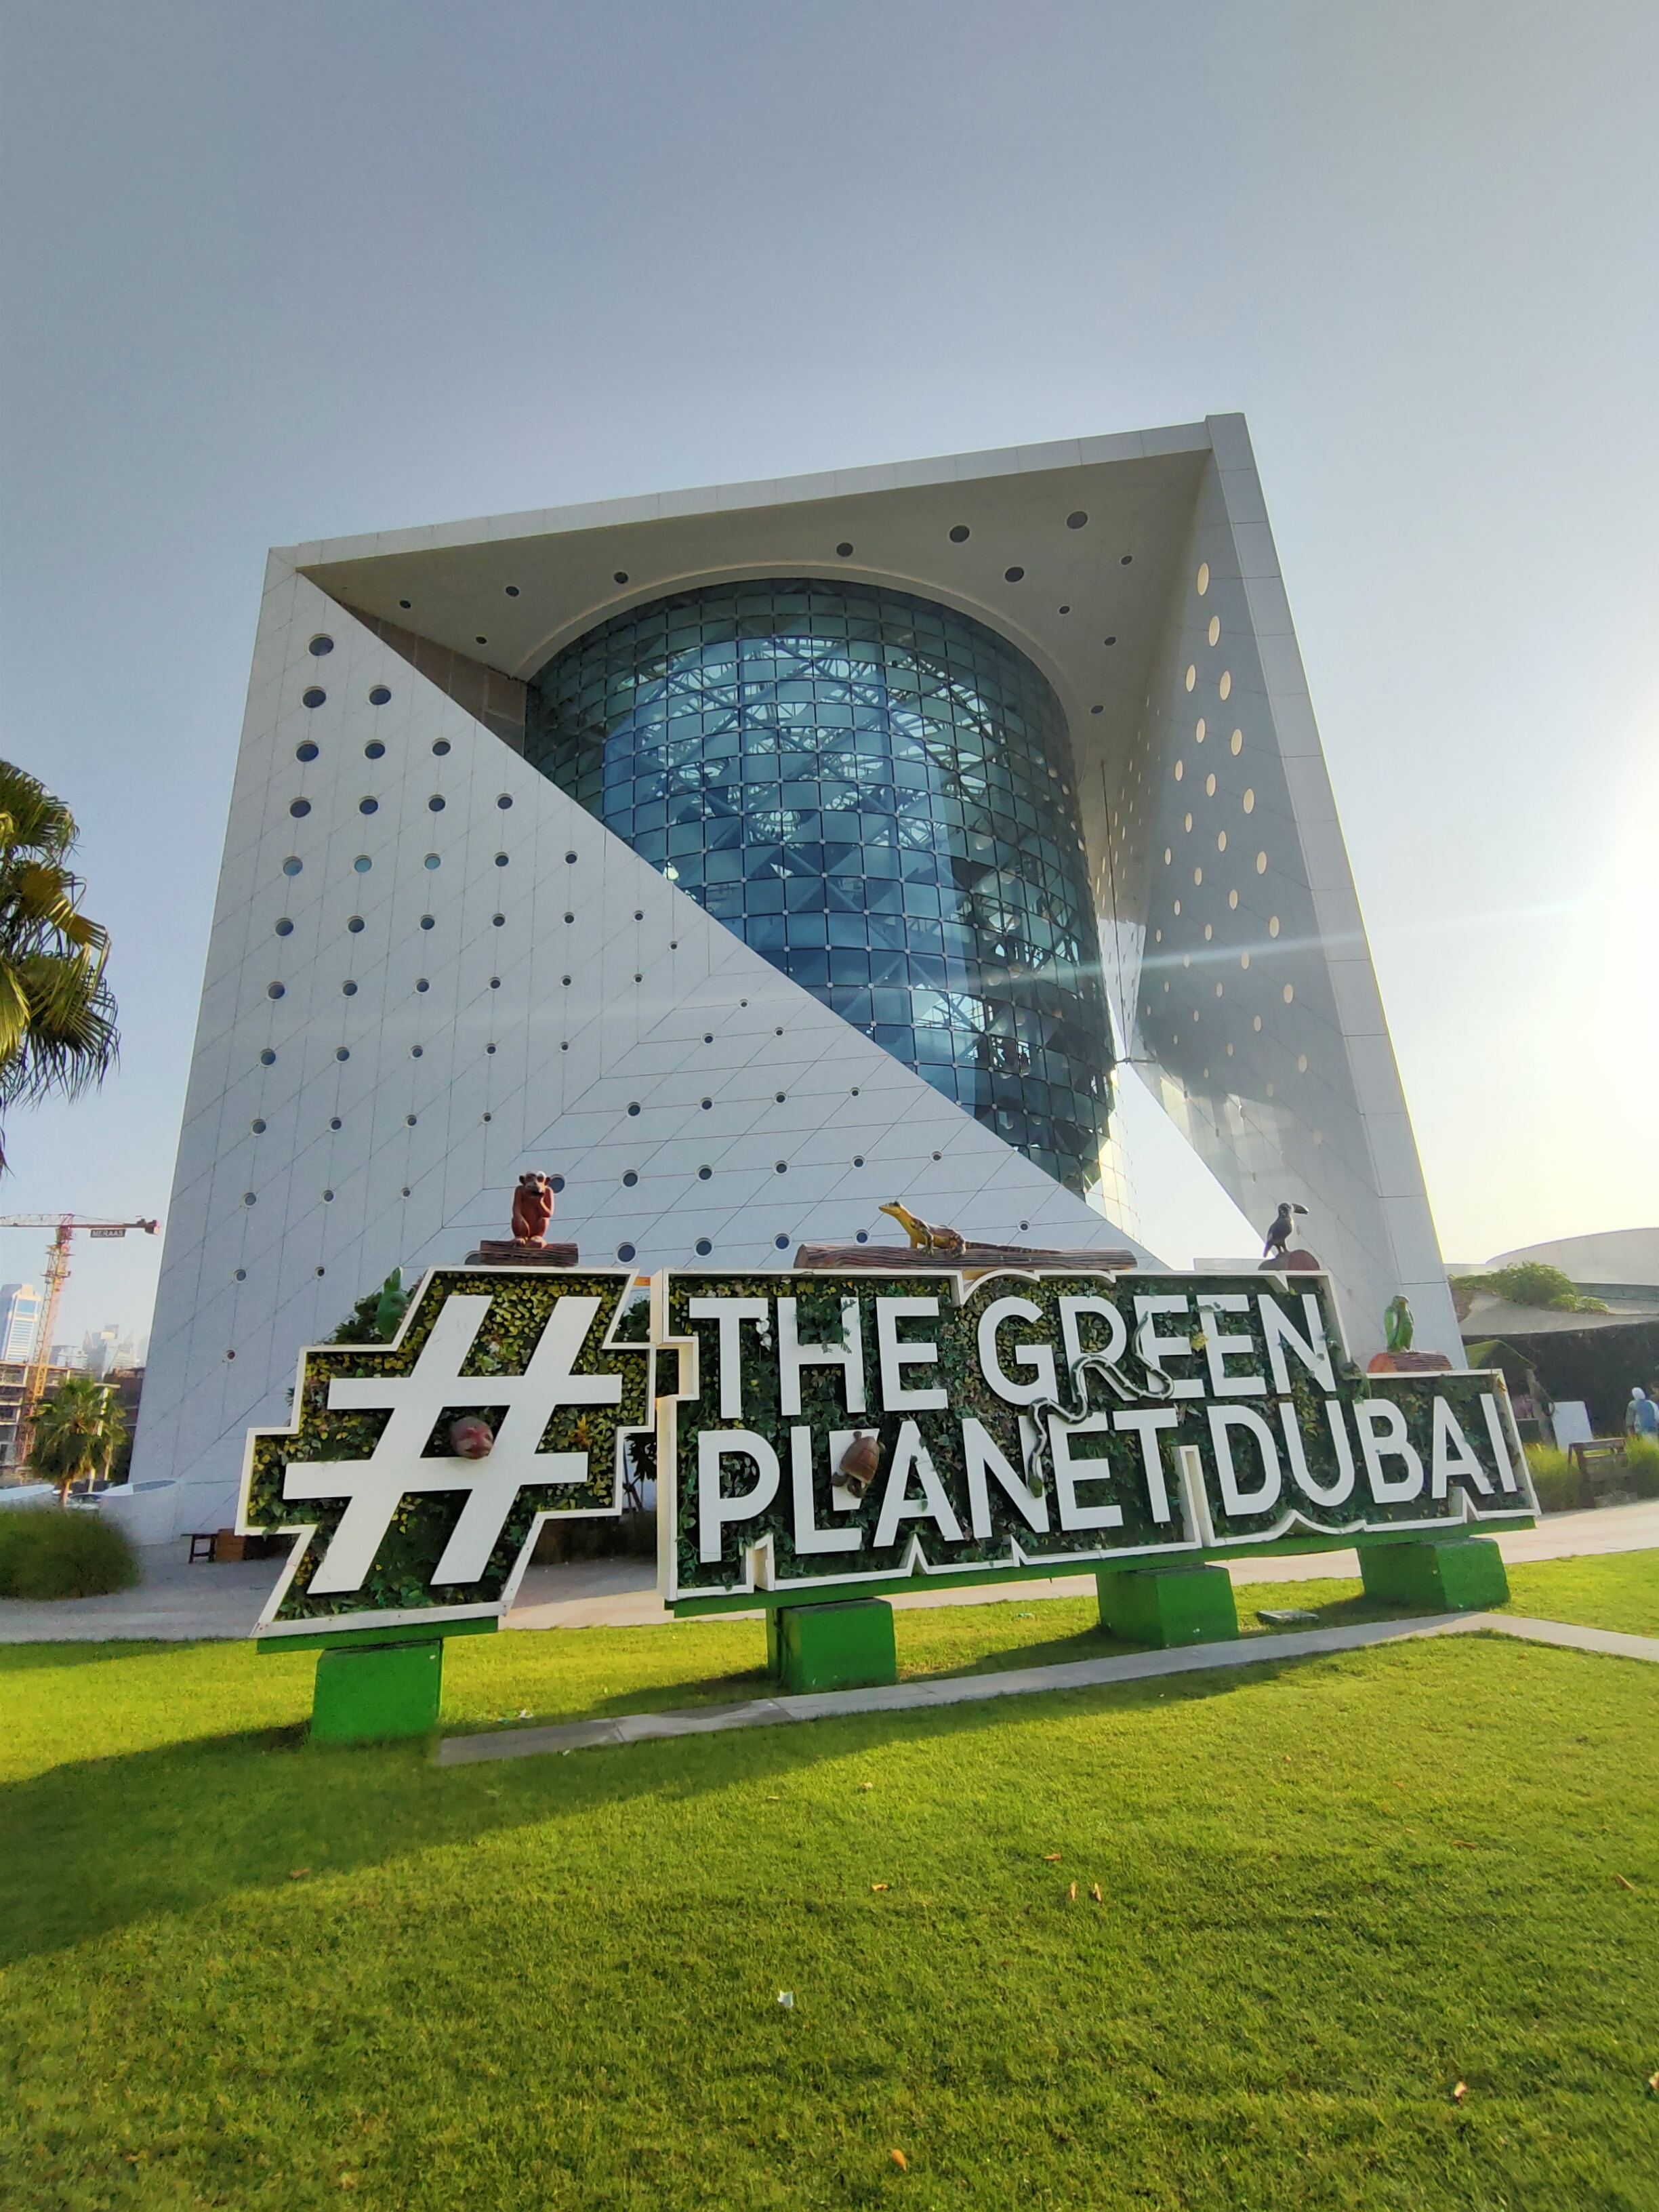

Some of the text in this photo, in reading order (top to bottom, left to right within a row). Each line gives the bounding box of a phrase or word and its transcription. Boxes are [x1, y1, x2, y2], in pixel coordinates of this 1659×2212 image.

[689, 1294, 1337, 1419] THE GREEN
[283, 1294, 623, 1594] #
[698, 1393, 1517, 1563] PLANET DUBAI
